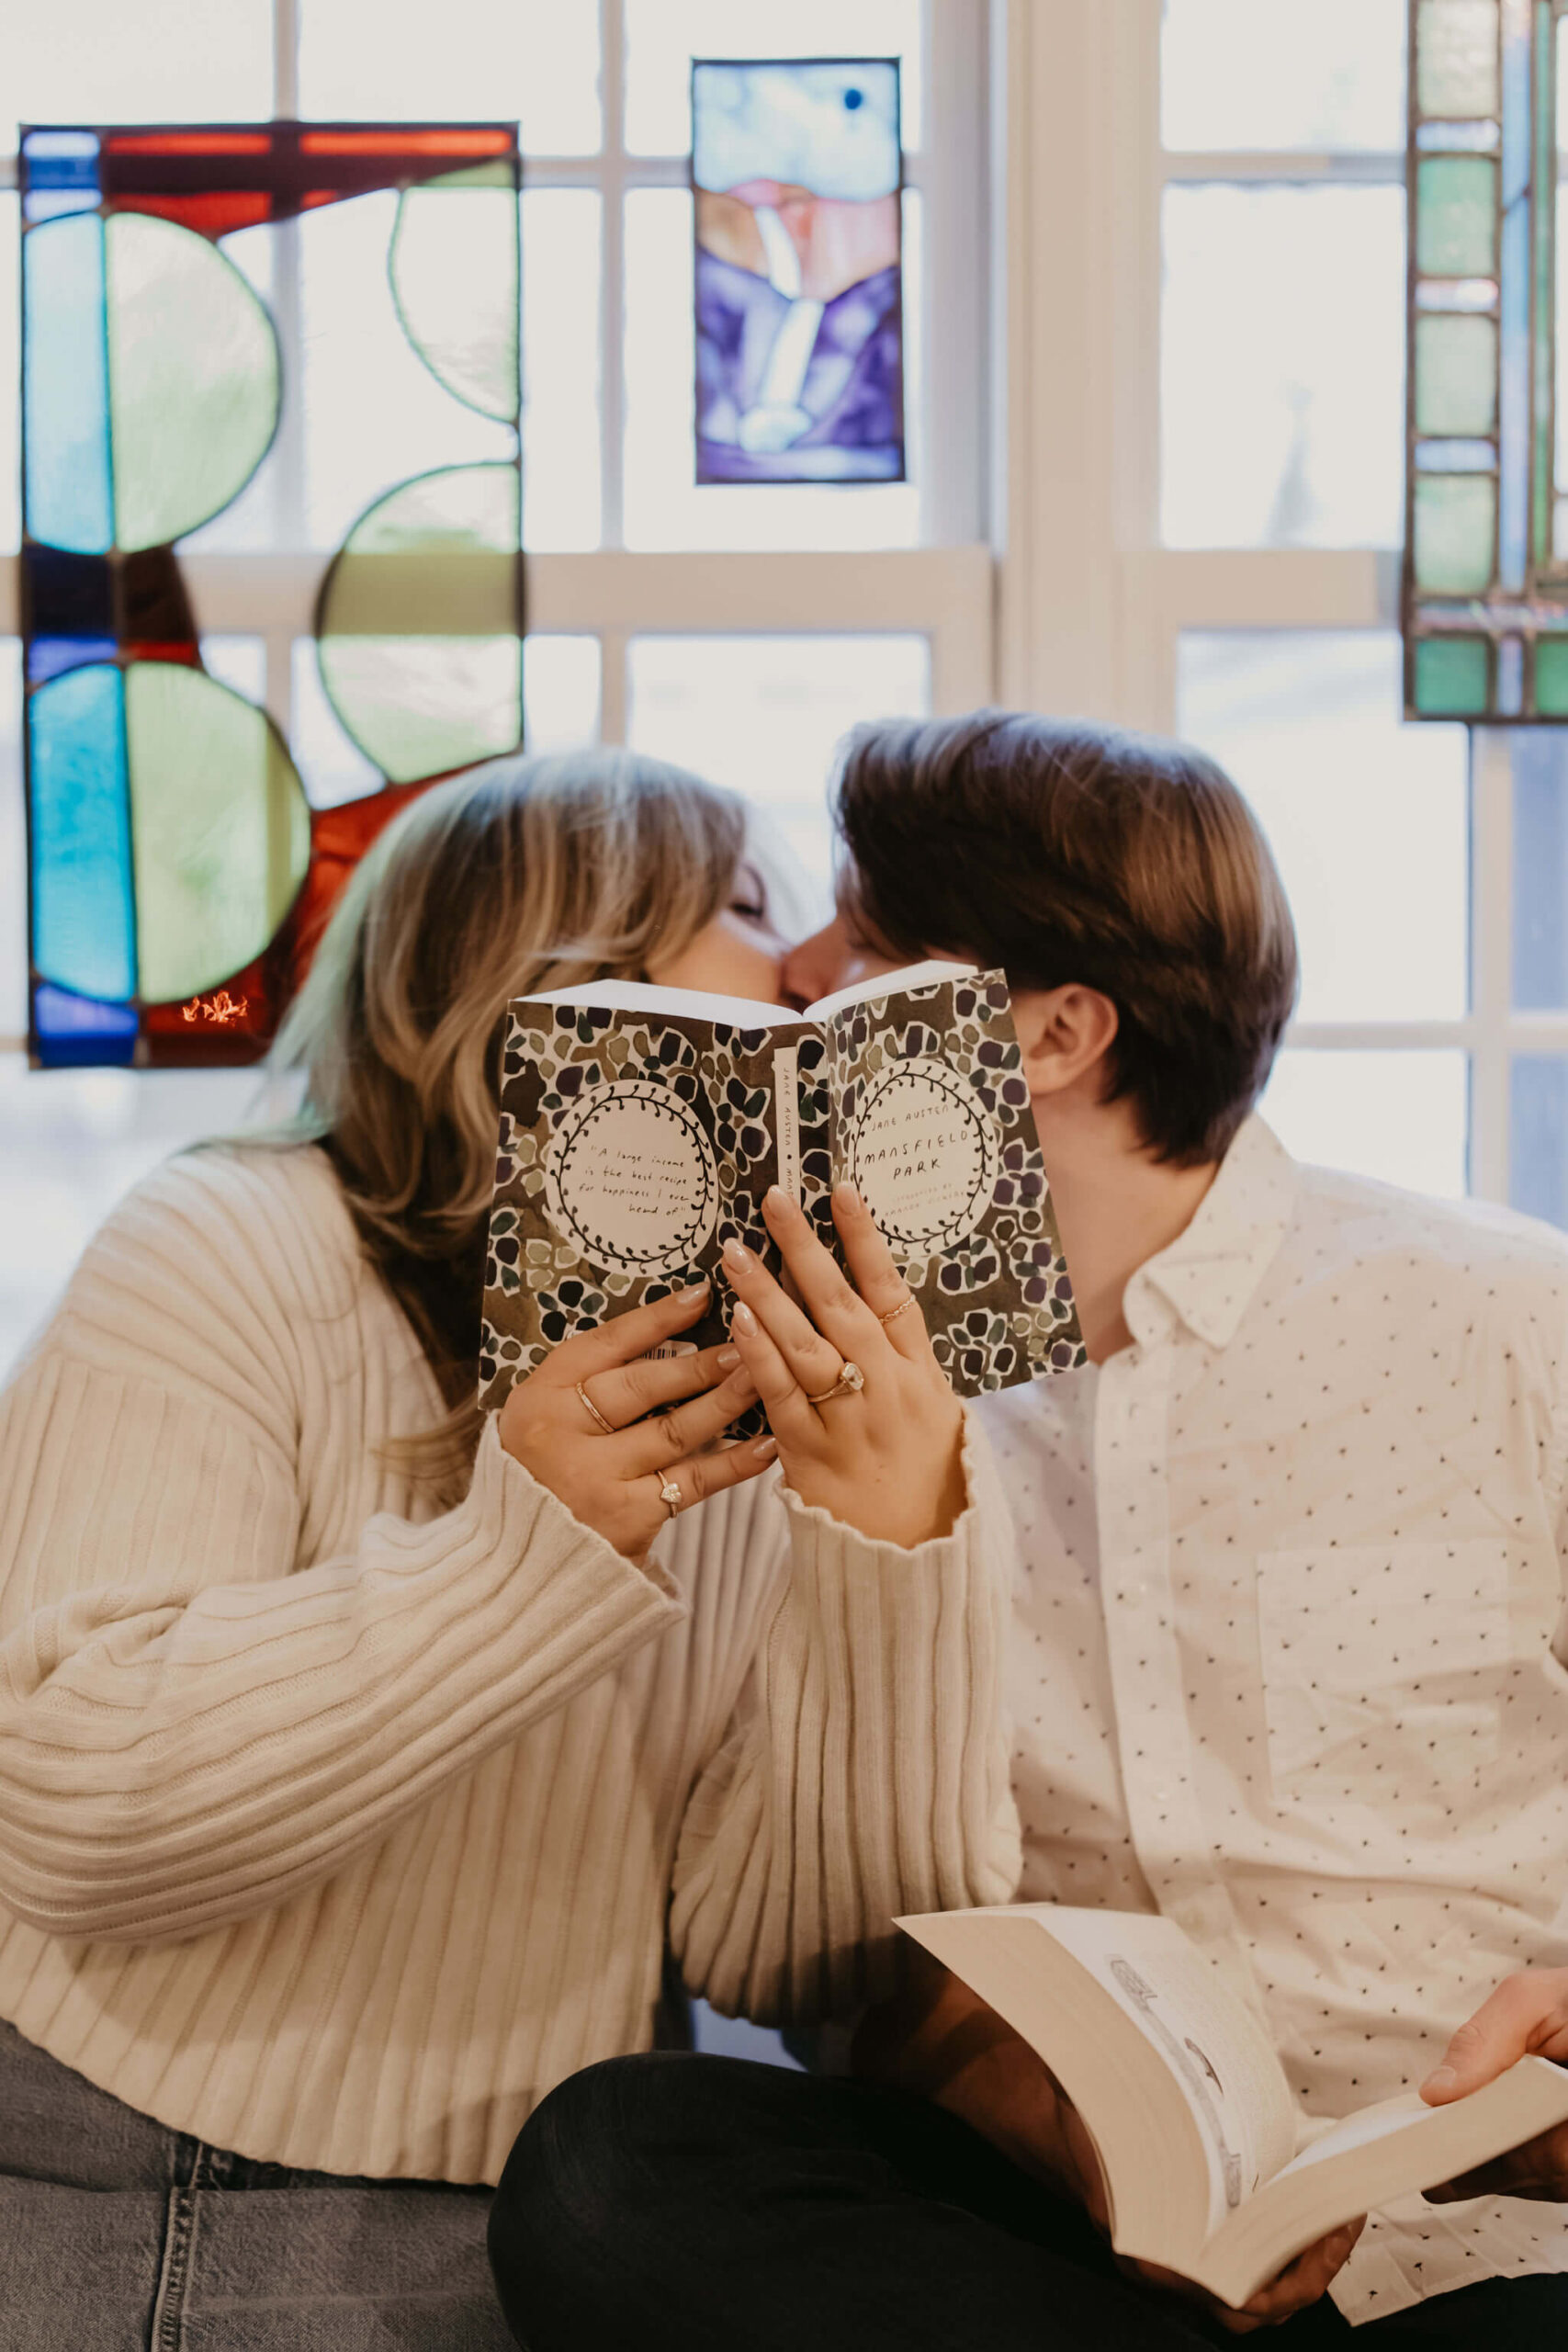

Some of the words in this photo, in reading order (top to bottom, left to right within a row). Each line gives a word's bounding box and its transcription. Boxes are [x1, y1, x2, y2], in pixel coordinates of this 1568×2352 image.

[782, 1068, 791, 1097] JANE
[784, 1106, 793, 1146] AUSTEN
[872, 1116, 897, 1132] JANE
[905, 1104, 949, 1122] AUSTEN
[864, 1130, 967, 1165] MANSFIELD
[616, 1149, 642, 1164] large
[651, 1155, 684, 1168] income
[585, 1166, 593, 1176] is
[603, 1165, 622, 1177] the
[632, 1170, 652, 1182] best
[660, 1175, 687, 1186] recipe
[893, 1159, 941, 1180] PARK
[579, 1182, 594, 1192] for
[603, 1184, 649, 1197] happiness
[670, 1193, 690, 1202] ever
[628, 1204, 659, 1214] heard
